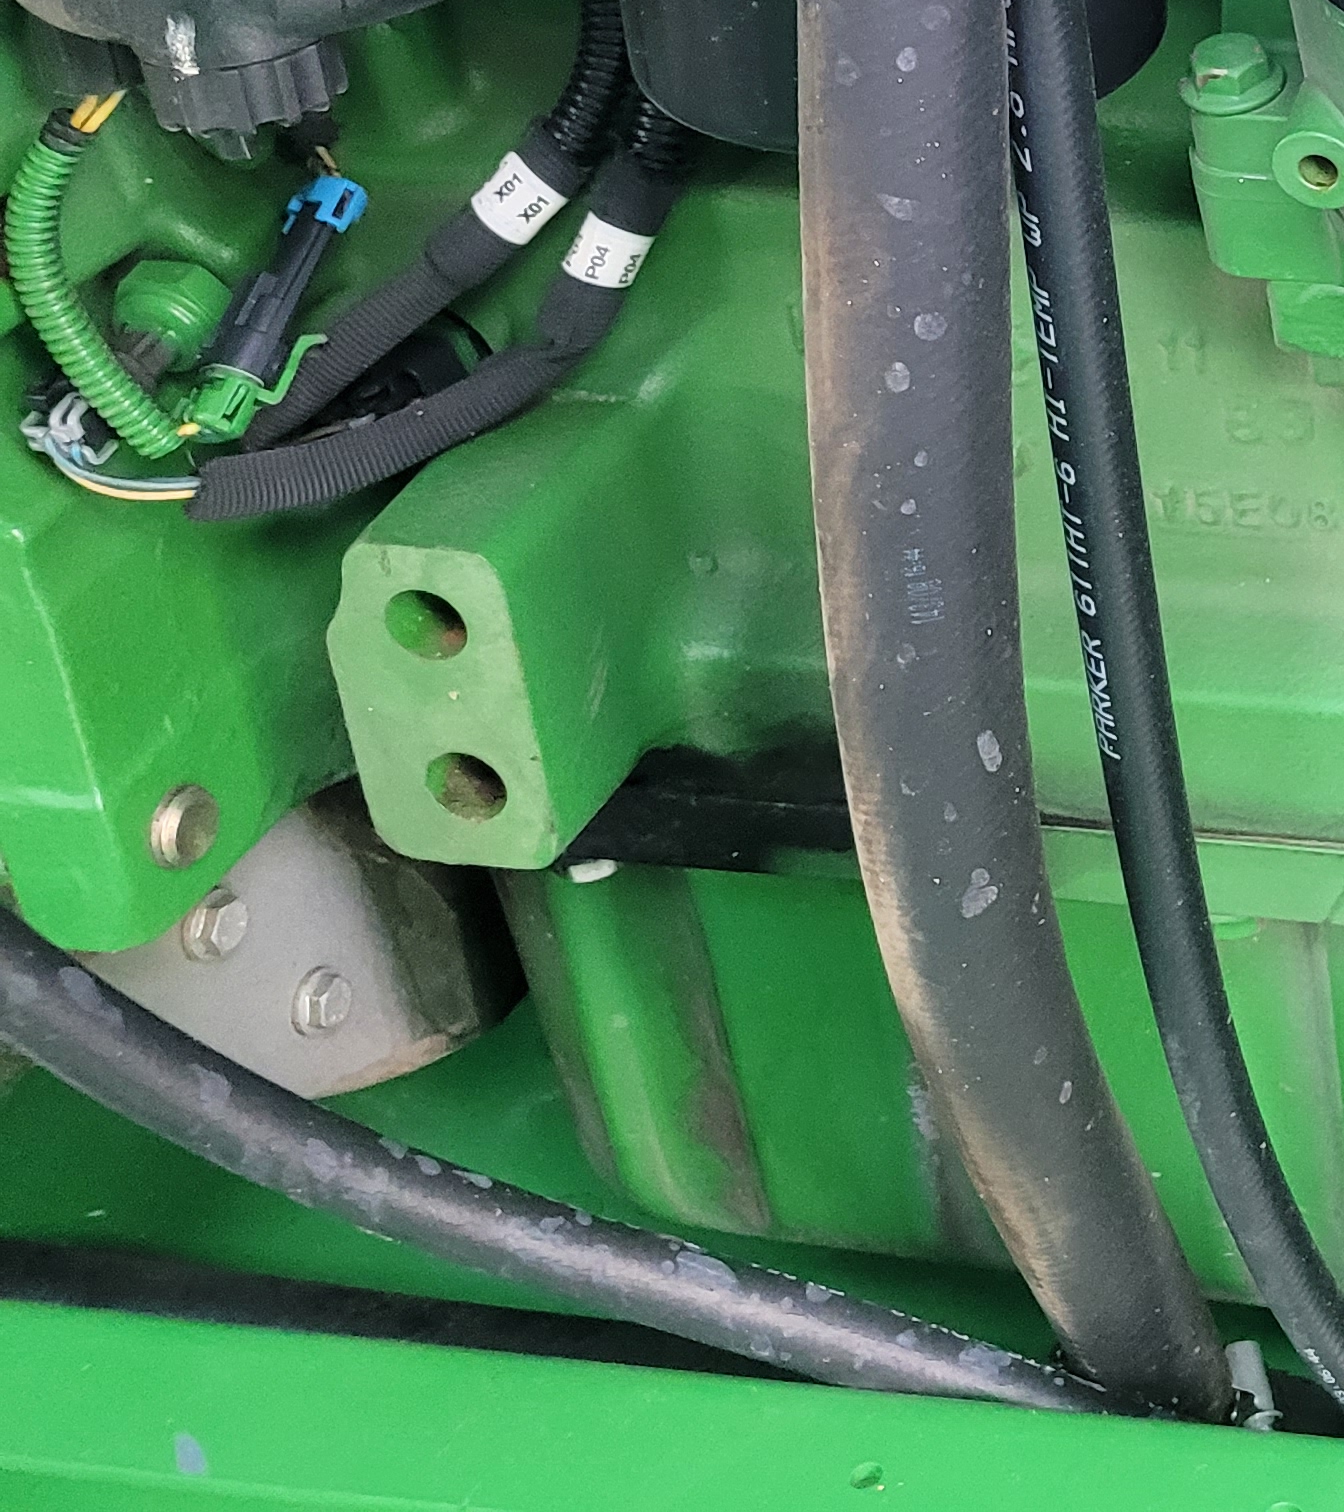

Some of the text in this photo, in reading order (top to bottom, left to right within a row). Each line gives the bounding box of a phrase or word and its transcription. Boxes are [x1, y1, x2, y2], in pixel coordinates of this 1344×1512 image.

[493, 173, 523, 203] X01
[517, 195, 549, 224] X01
[584, 245, 610, 280] P04
[1080, 630, 1122, 759] PARKER
